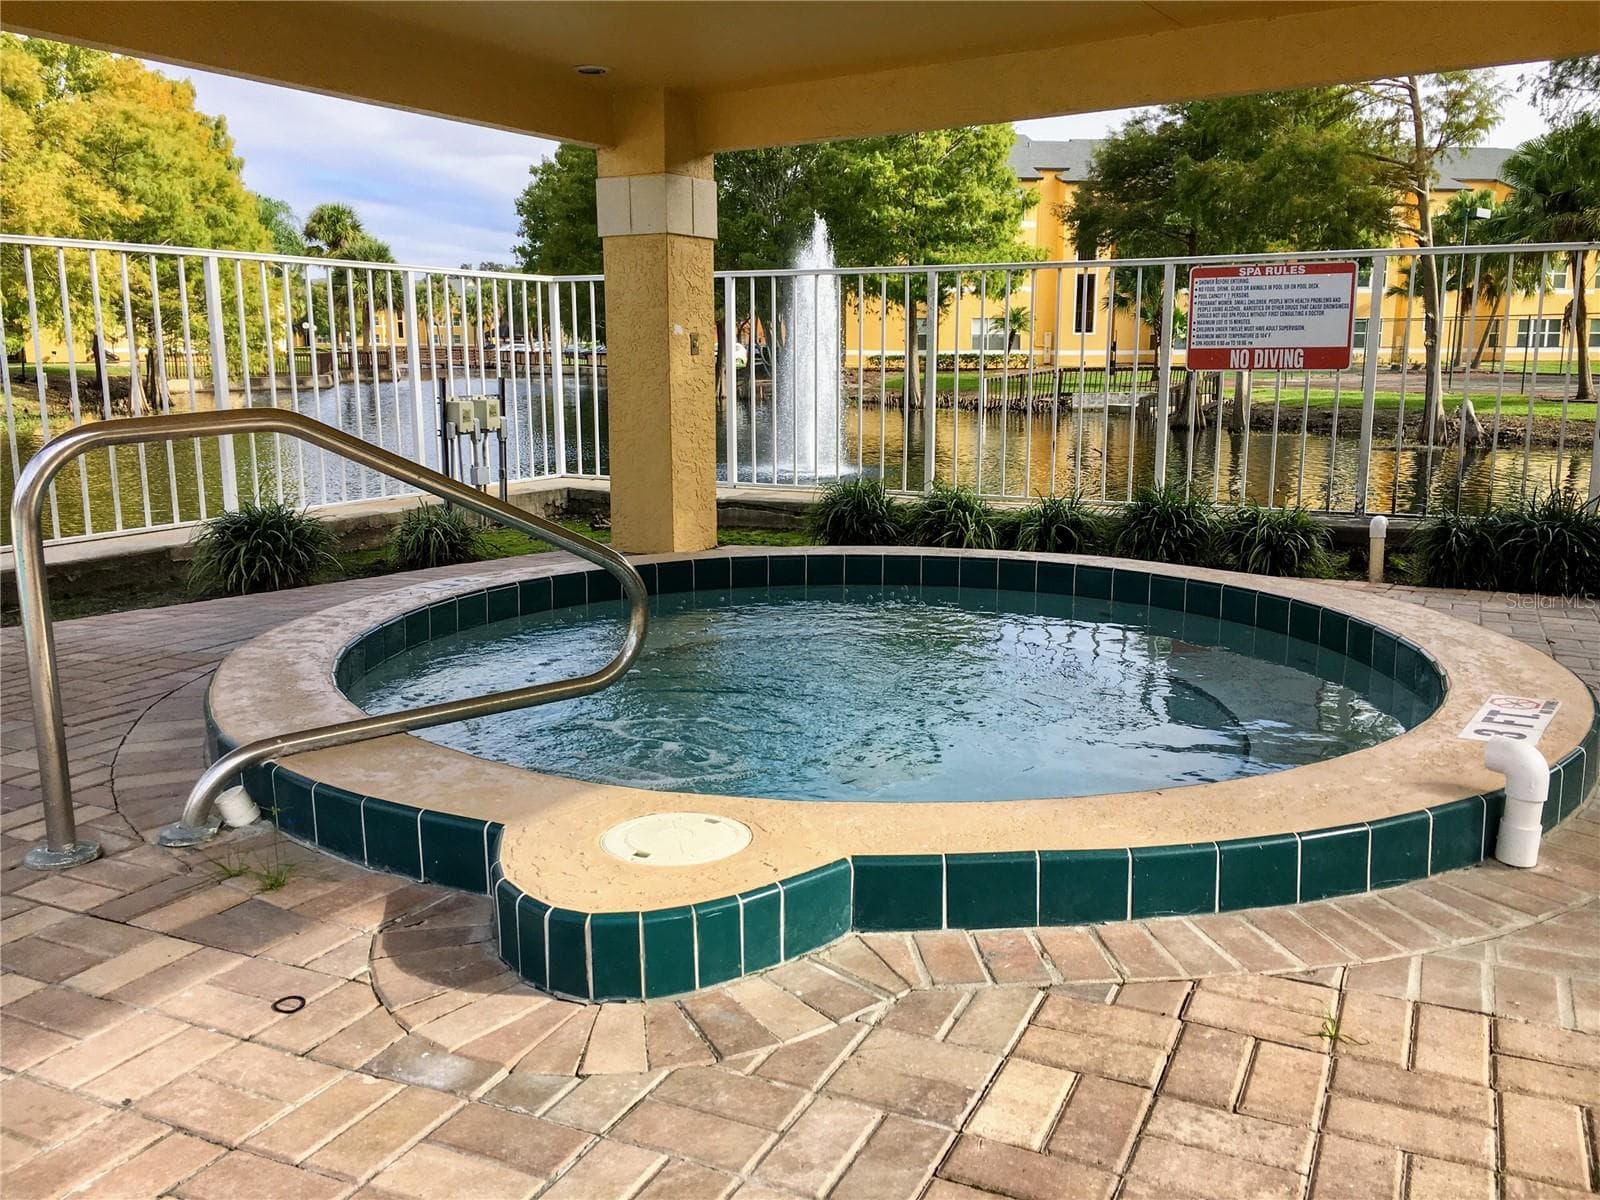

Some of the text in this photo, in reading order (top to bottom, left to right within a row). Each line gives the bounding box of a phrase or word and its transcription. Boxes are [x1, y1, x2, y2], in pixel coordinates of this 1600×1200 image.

[1239, 265, 1306, 276] SPA RULES
[1230, 348, 1304, 368] NO DIVING
[1473, 728, 1528, 740] 3
